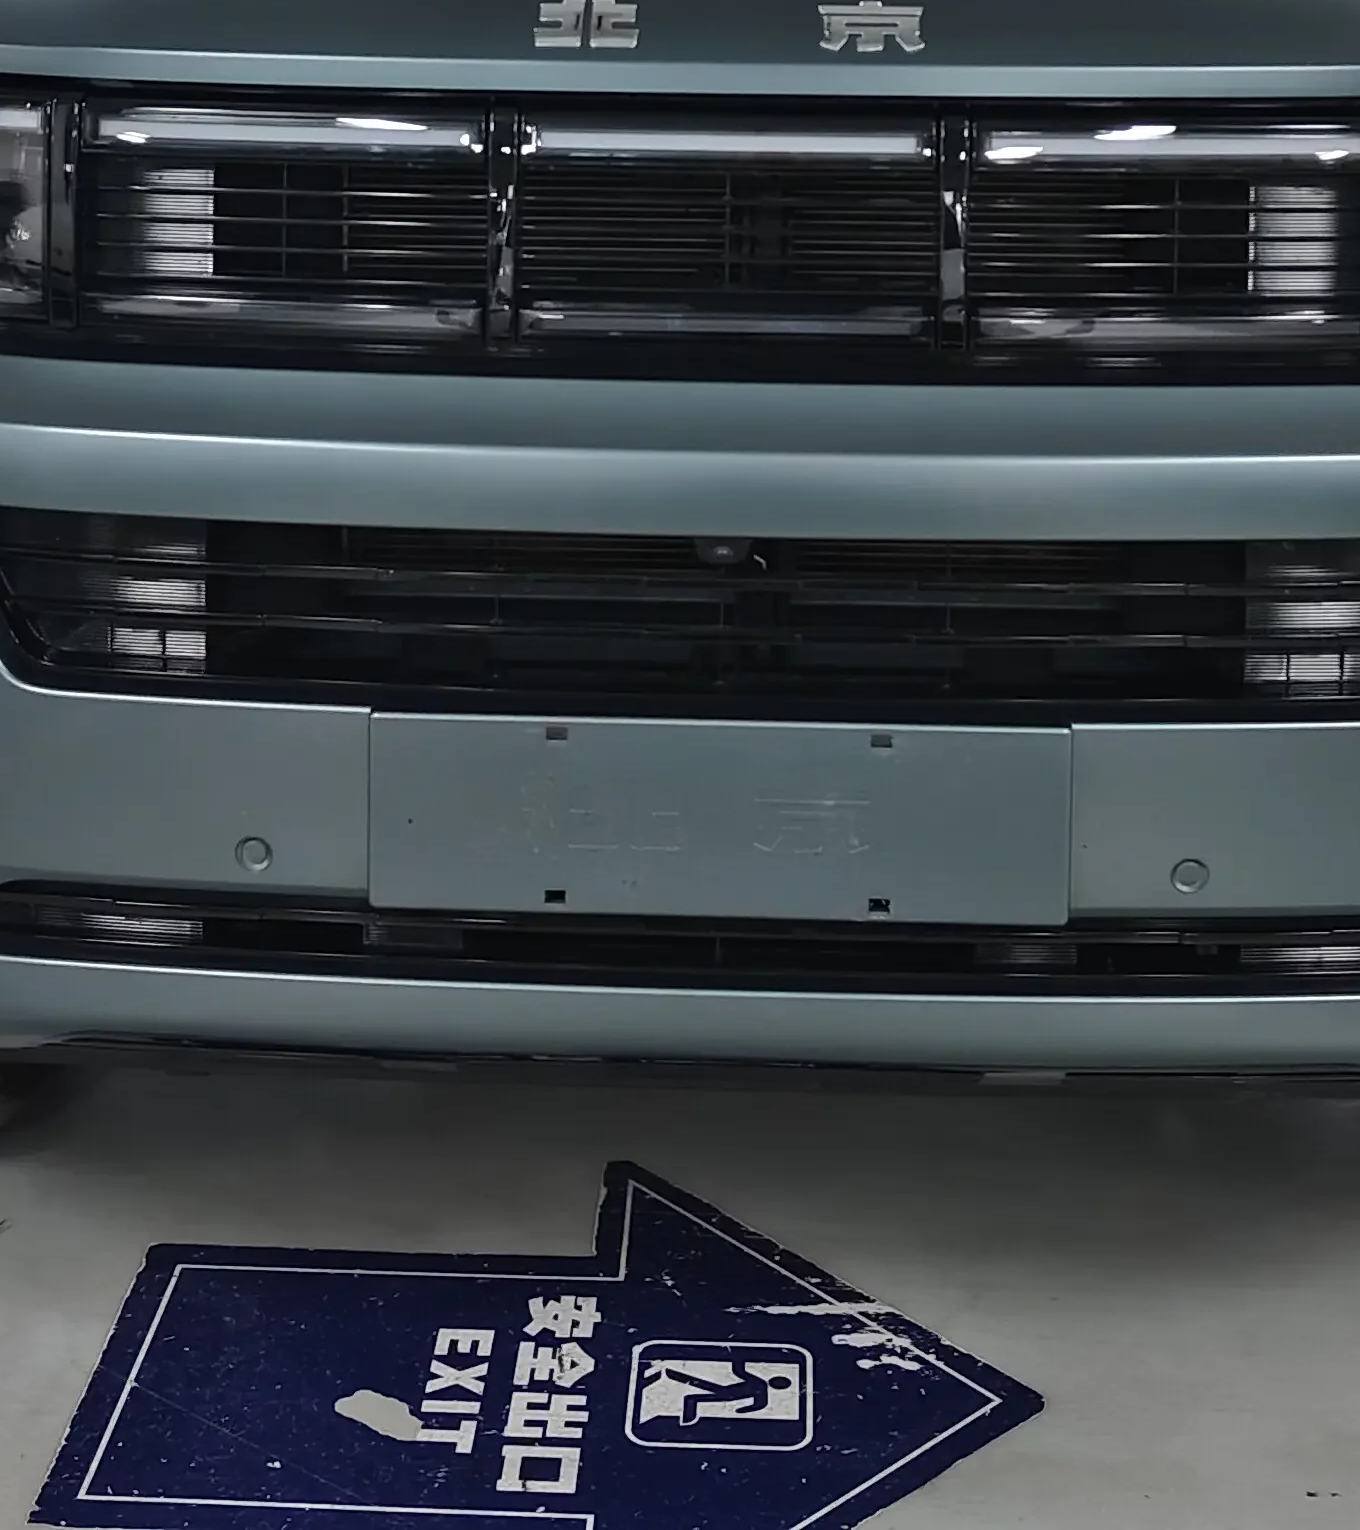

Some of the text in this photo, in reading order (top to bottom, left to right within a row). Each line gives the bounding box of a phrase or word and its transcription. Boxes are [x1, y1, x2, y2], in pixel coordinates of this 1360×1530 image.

[416, 1327, 496, 1454] EXIT
[496, 1295, 602, 1494] 安全出口
